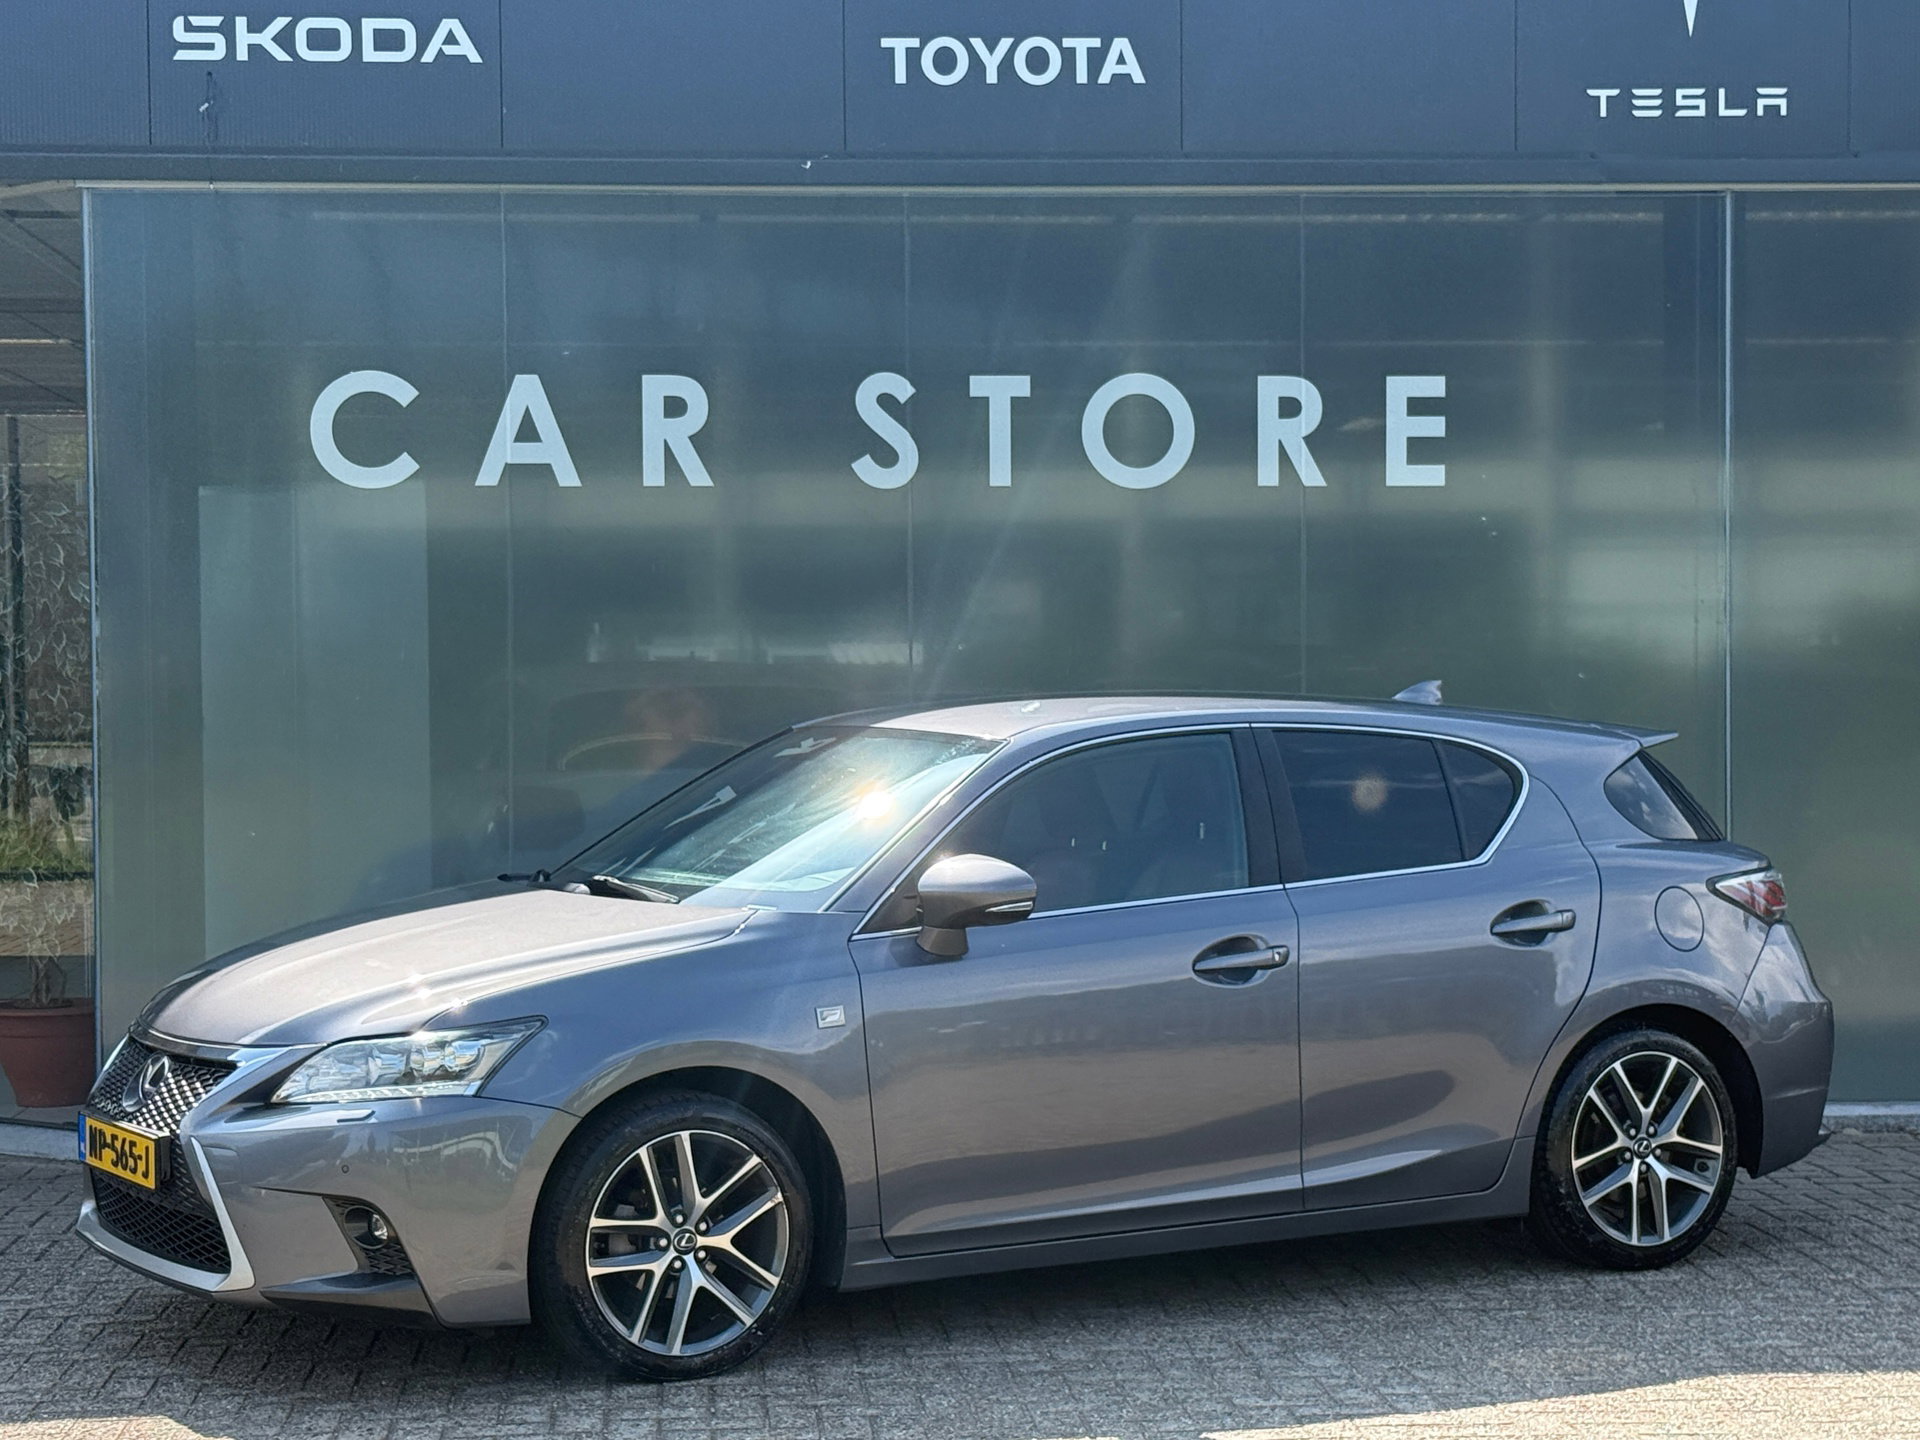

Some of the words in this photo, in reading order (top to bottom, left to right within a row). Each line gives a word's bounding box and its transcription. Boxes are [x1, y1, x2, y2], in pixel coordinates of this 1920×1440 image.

[172, 16, 483, 63] SKODA
[881, 36, 1146, 86] TOYOTA
[1586, 87, 1788, 118] TESLA
[310, 370, 714, 489] CAR
[851, 372, 1446, 489] STORE
[89, 1124, 150, 1180] NP-565-J
